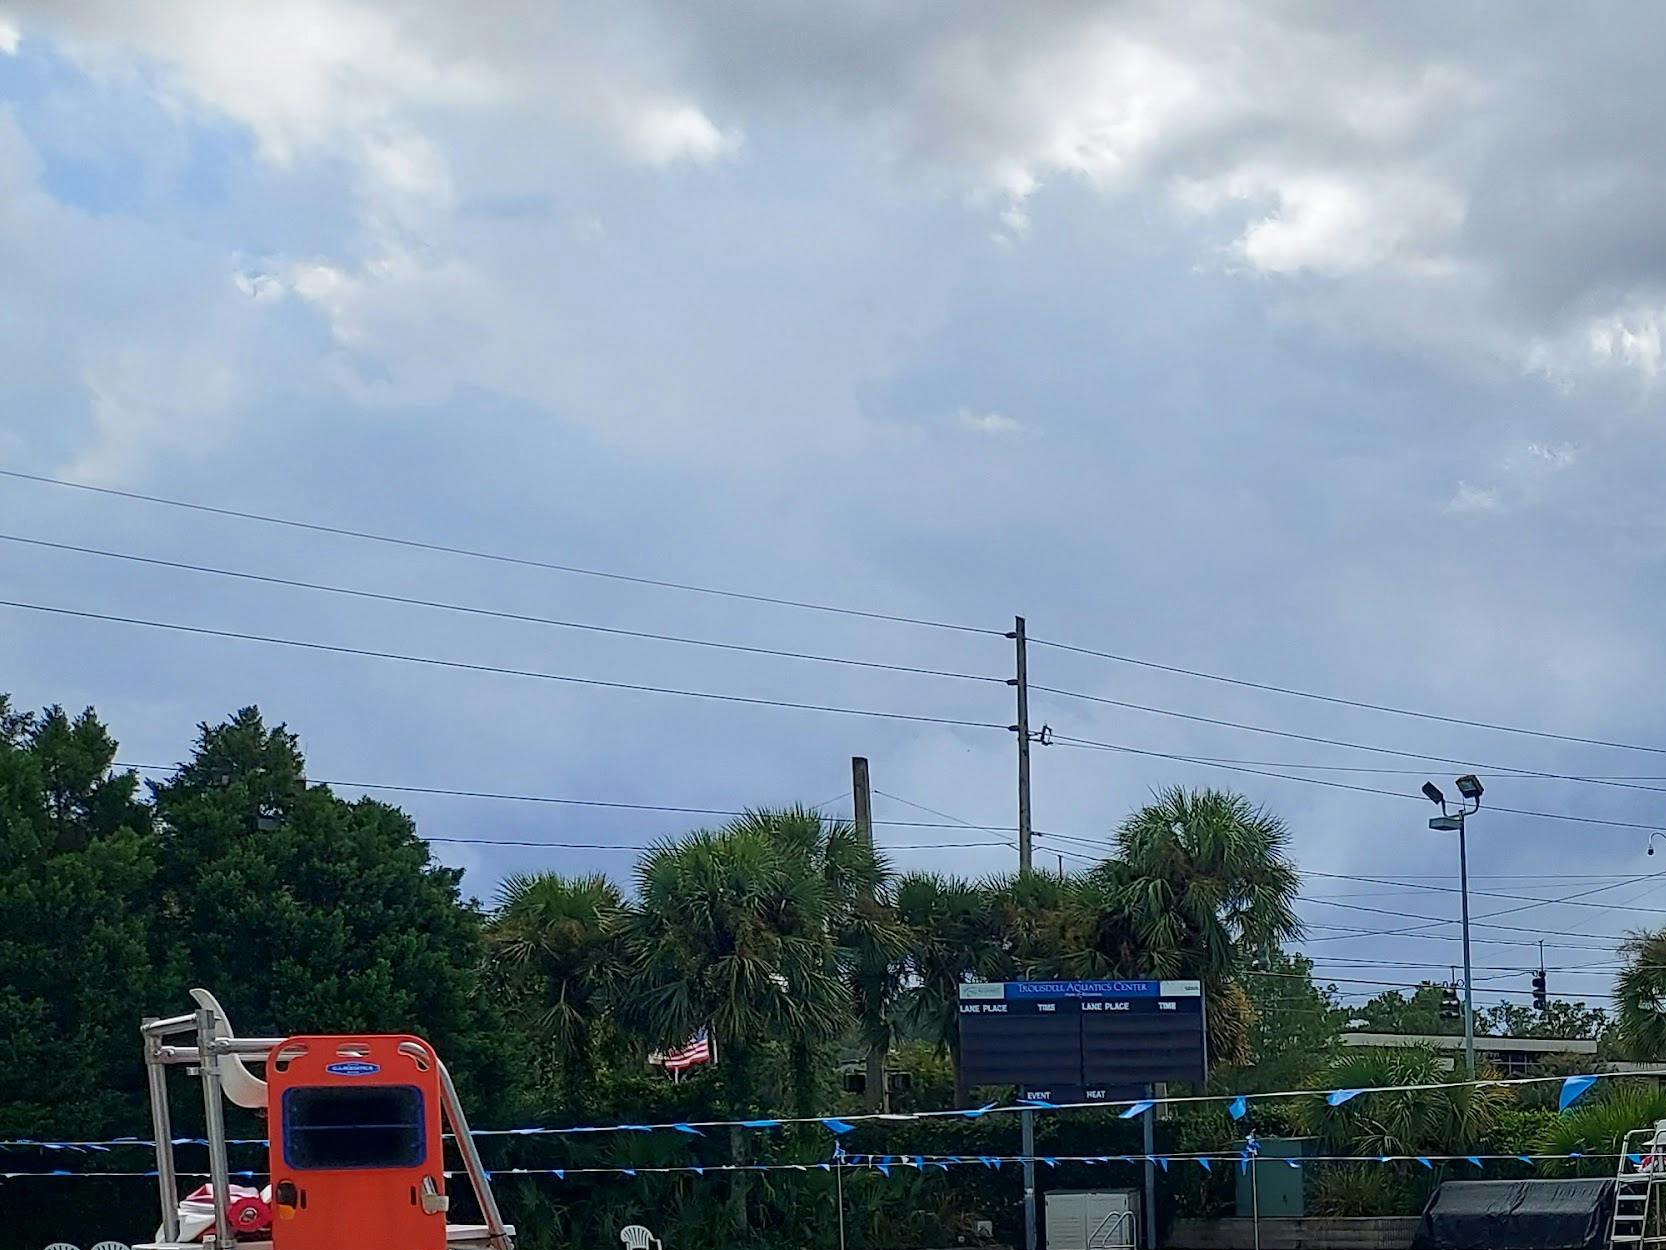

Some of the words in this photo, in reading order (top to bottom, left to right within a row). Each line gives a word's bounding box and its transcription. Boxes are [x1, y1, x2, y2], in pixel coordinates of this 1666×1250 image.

[1066, 982, 1112, 993] AQUATICS
[1113, 982, 1148, 991] CENTER
[960, 1004, 980, 1013] LANE
[982, 1004, 1008, 1012] PLACE
[1037, 1003, 1056, 1012] TIME
[1081, 1002, 1103, 1011] LANE
[1104, 1002, 1130, 1010] PLACE
[1158, 1001, 1176, 1010] TIME
[1027, 1091, 1051, 1100] EVENT
[1086, 1090, 1106, 1099] HEAT
